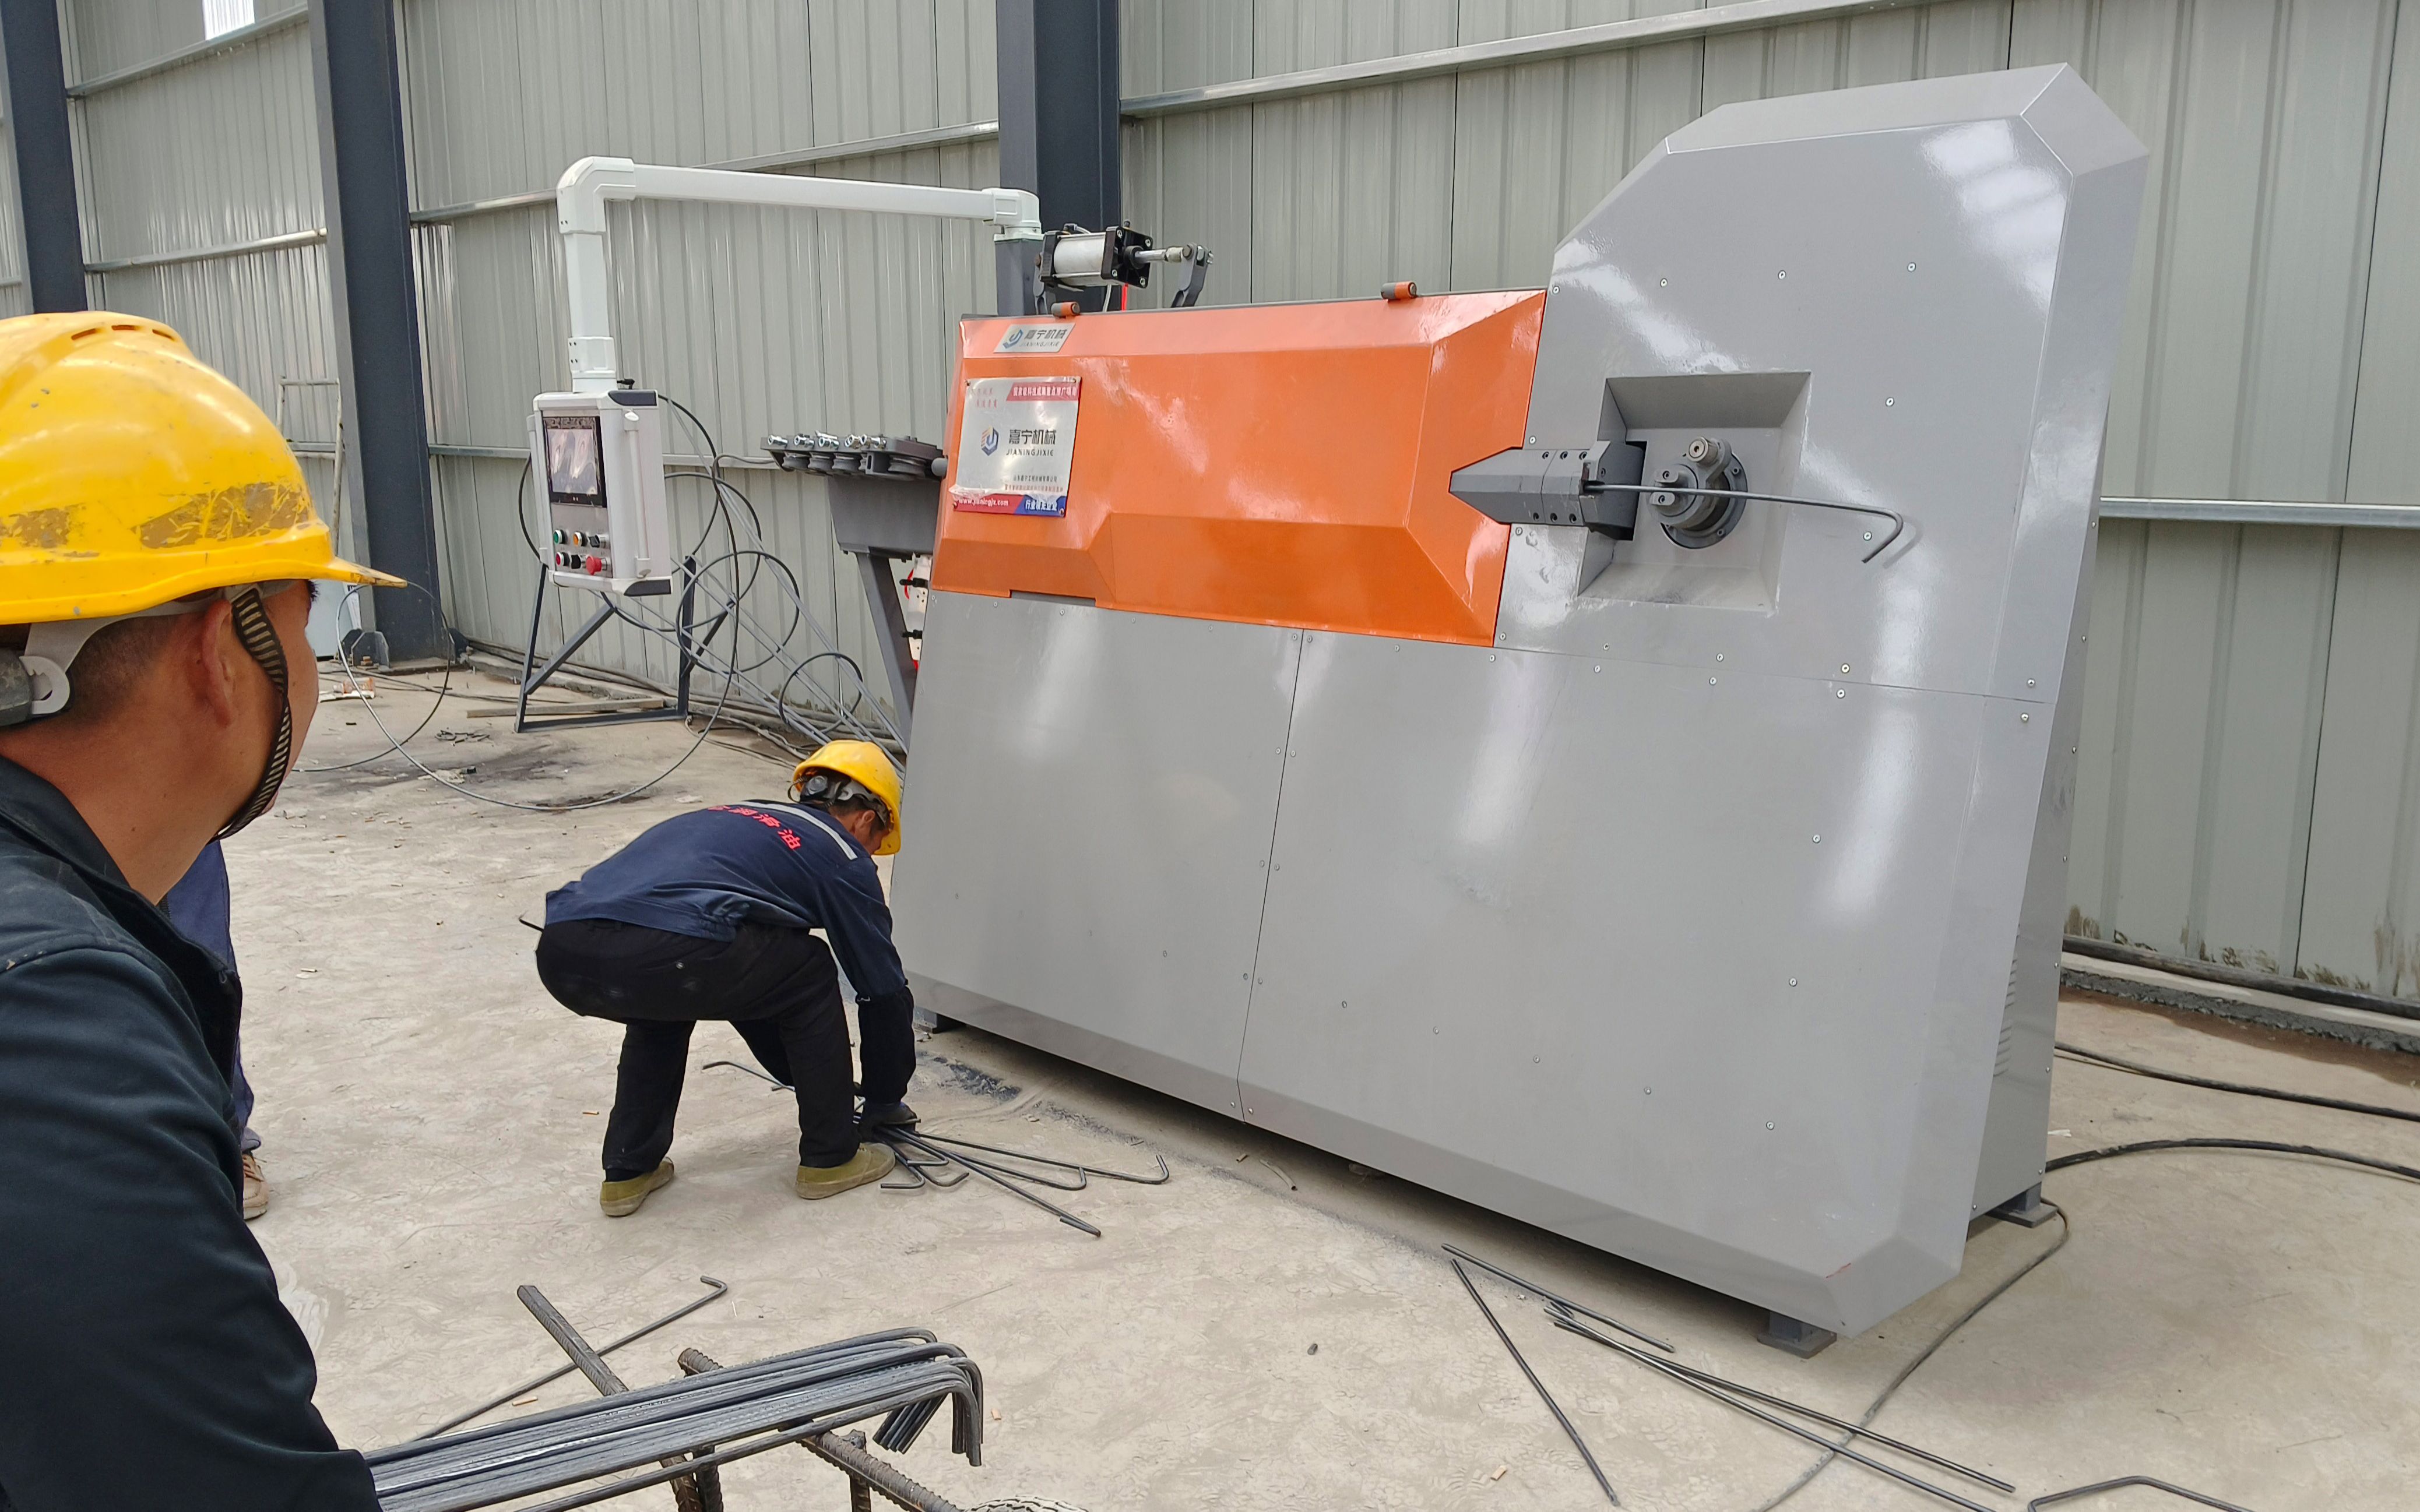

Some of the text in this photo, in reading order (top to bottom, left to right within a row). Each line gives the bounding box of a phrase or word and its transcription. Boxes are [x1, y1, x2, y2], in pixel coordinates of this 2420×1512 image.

[1024, 329, 1068, 340] 嘉宁机械
[1008, 429, 1057, 445] 嘉宁机械
